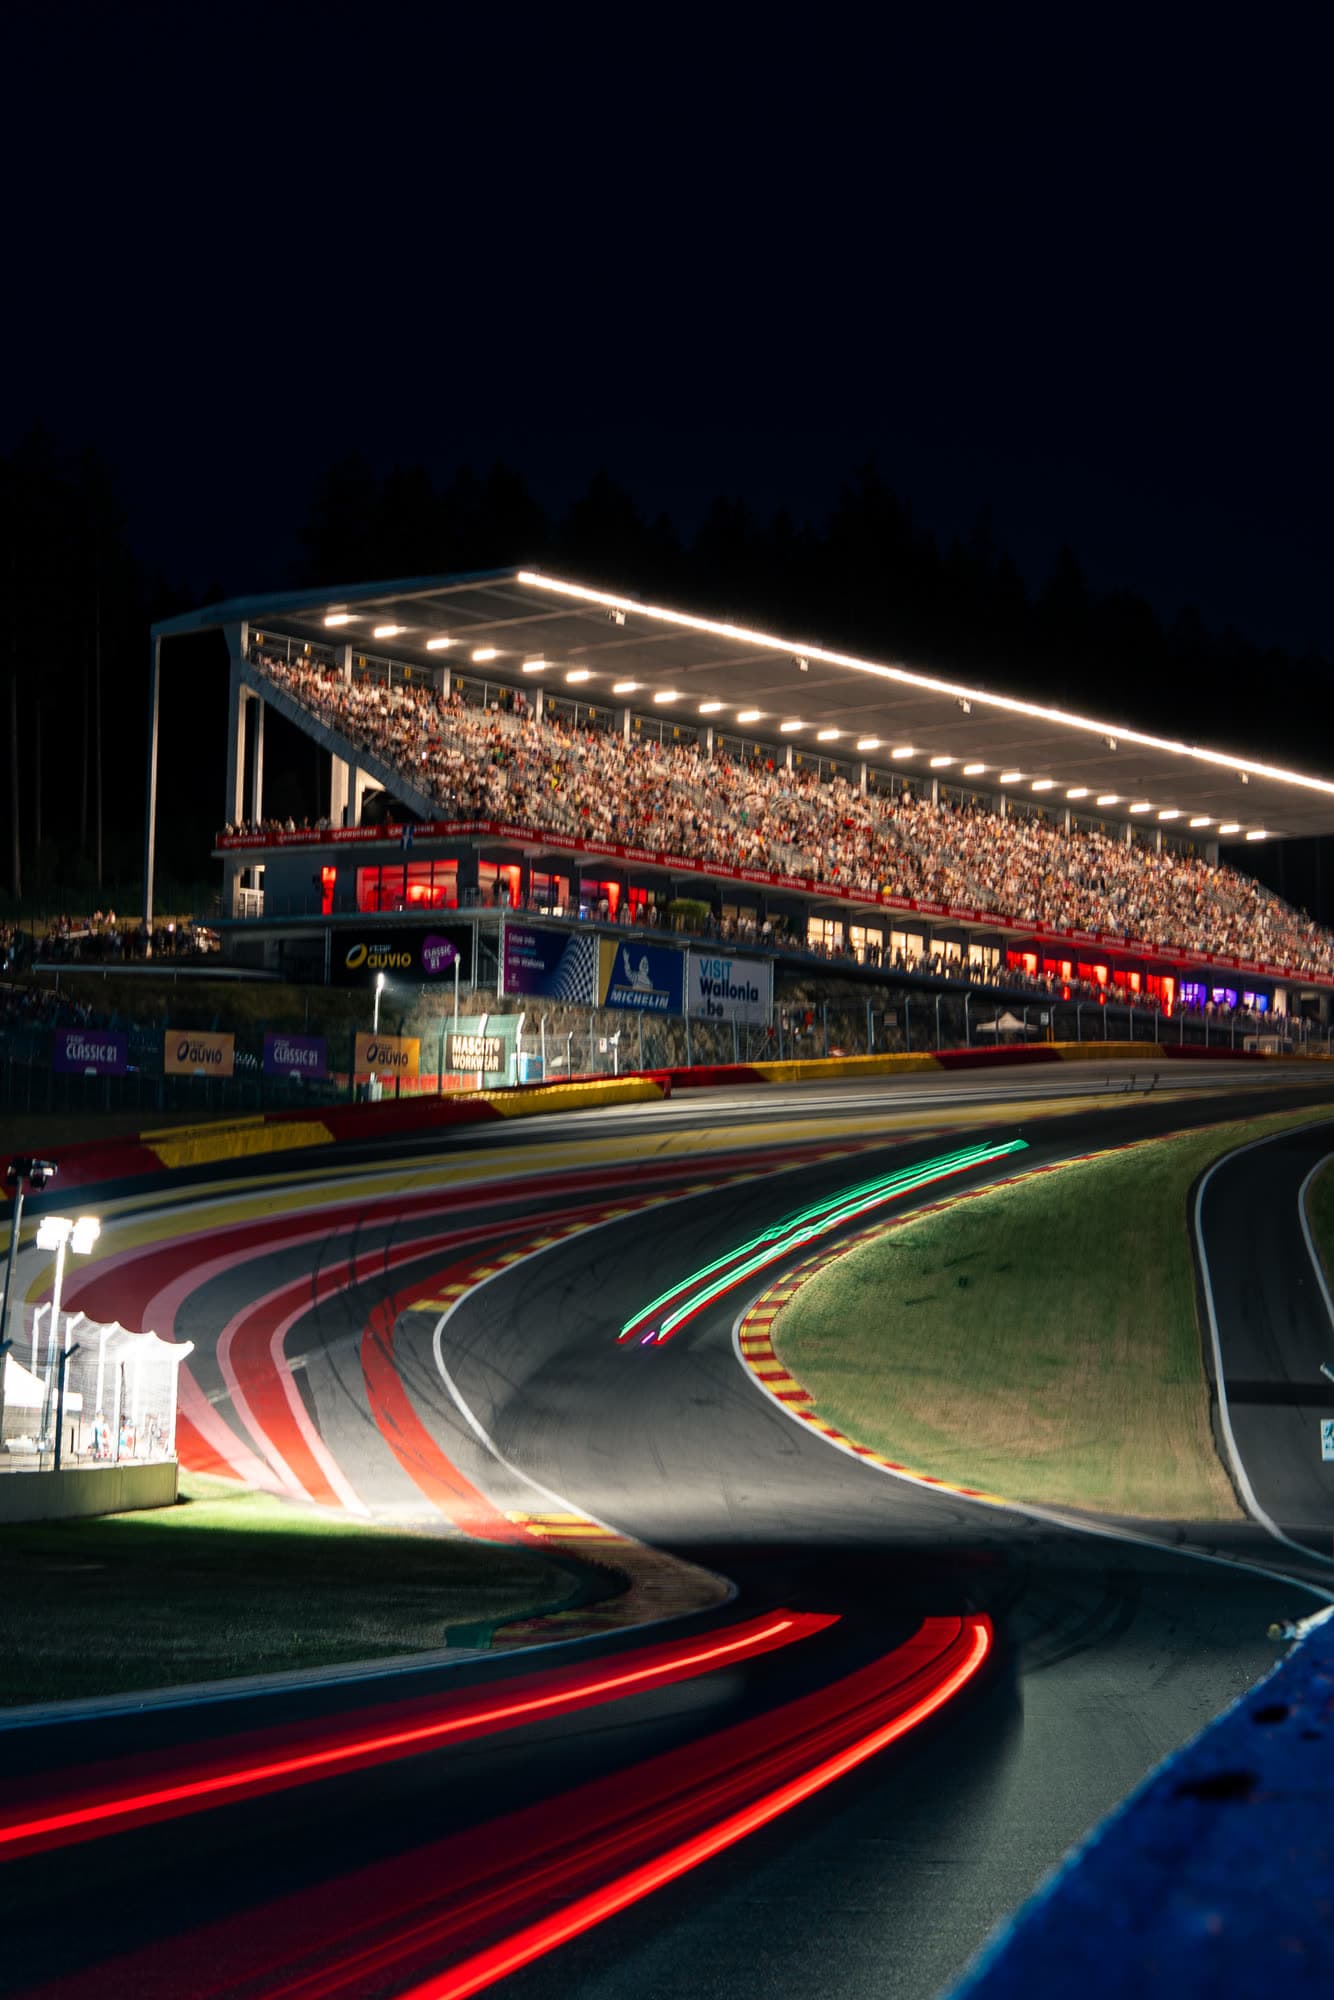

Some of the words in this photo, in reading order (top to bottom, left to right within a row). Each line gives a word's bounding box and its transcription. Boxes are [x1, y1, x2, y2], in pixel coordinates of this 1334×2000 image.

[700, 959, 733, 978] VISIT
[700, 977, 759, 1001] Wallonia
[610, 991, 669, 1009] MICHELIN
[66, 1043, 106, 1062] CLASSIC
[452, 1054, 499, 1071] WORKWEAR
